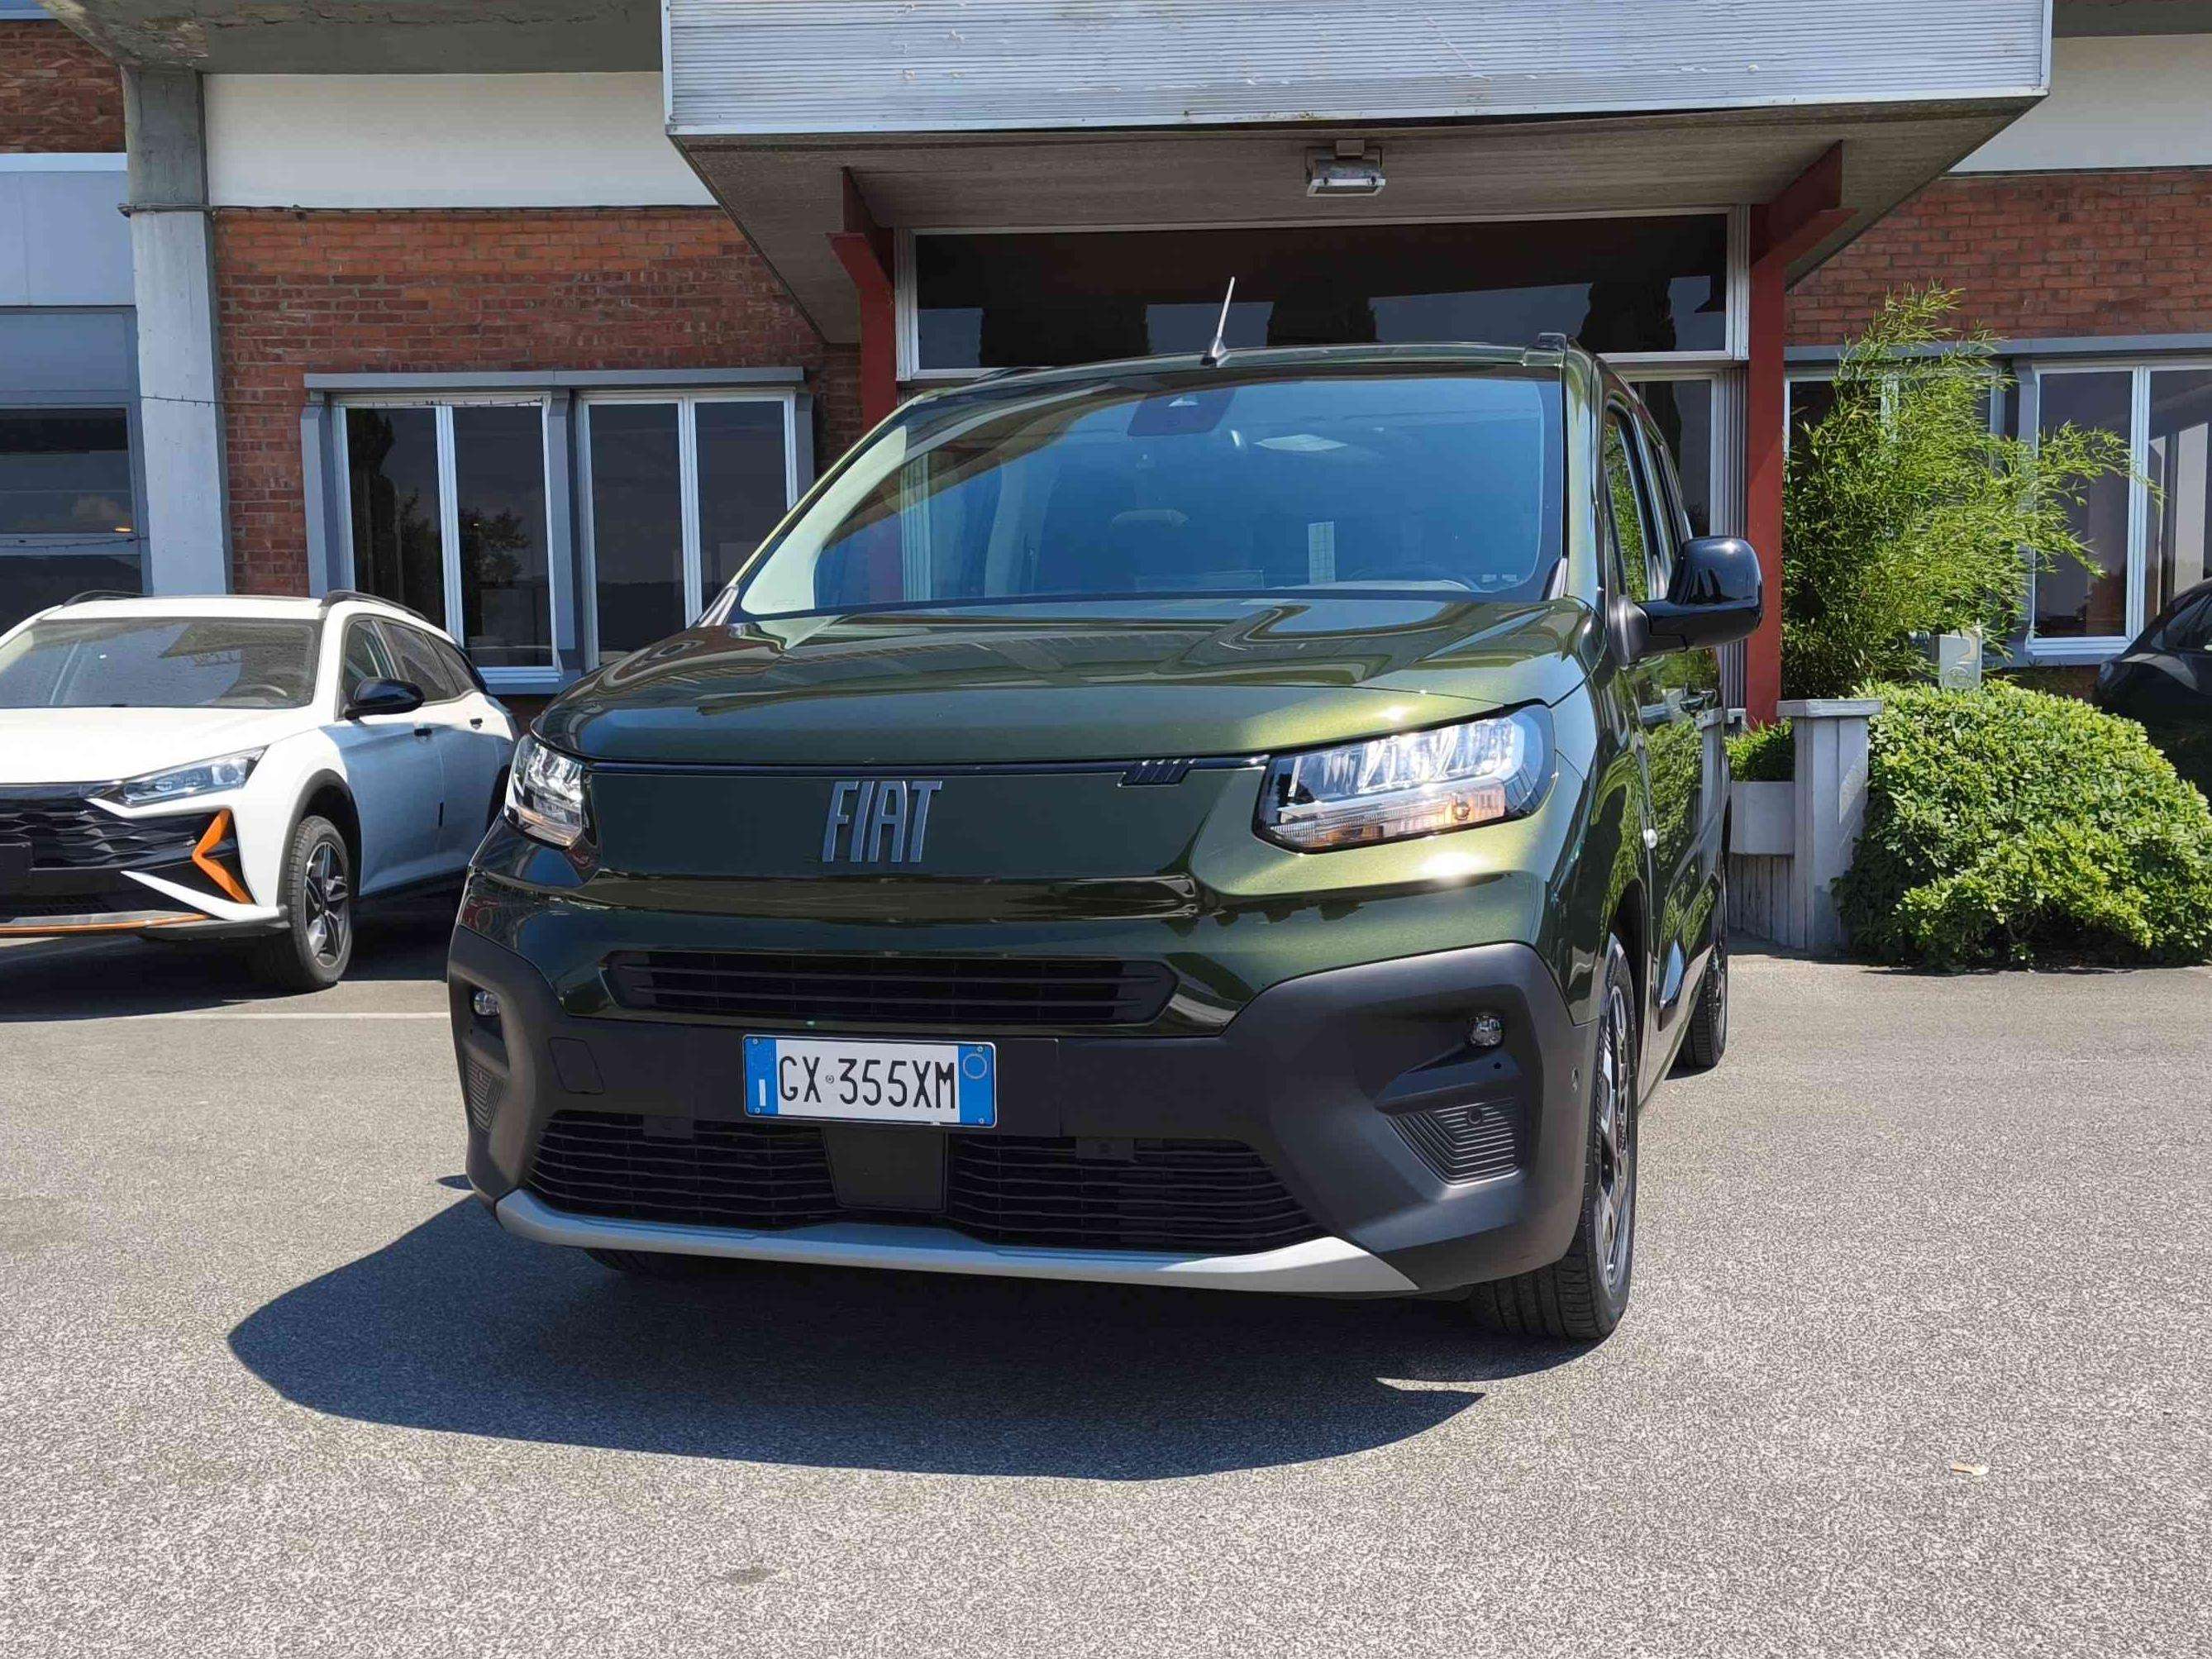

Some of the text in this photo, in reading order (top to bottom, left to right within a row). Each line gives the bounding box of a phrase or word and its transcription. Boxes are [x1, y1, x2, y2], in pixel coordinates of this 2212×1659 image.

[822, 780, 942, 862] FIAT
[779, 1056, 956, 1109] GX 355XM
